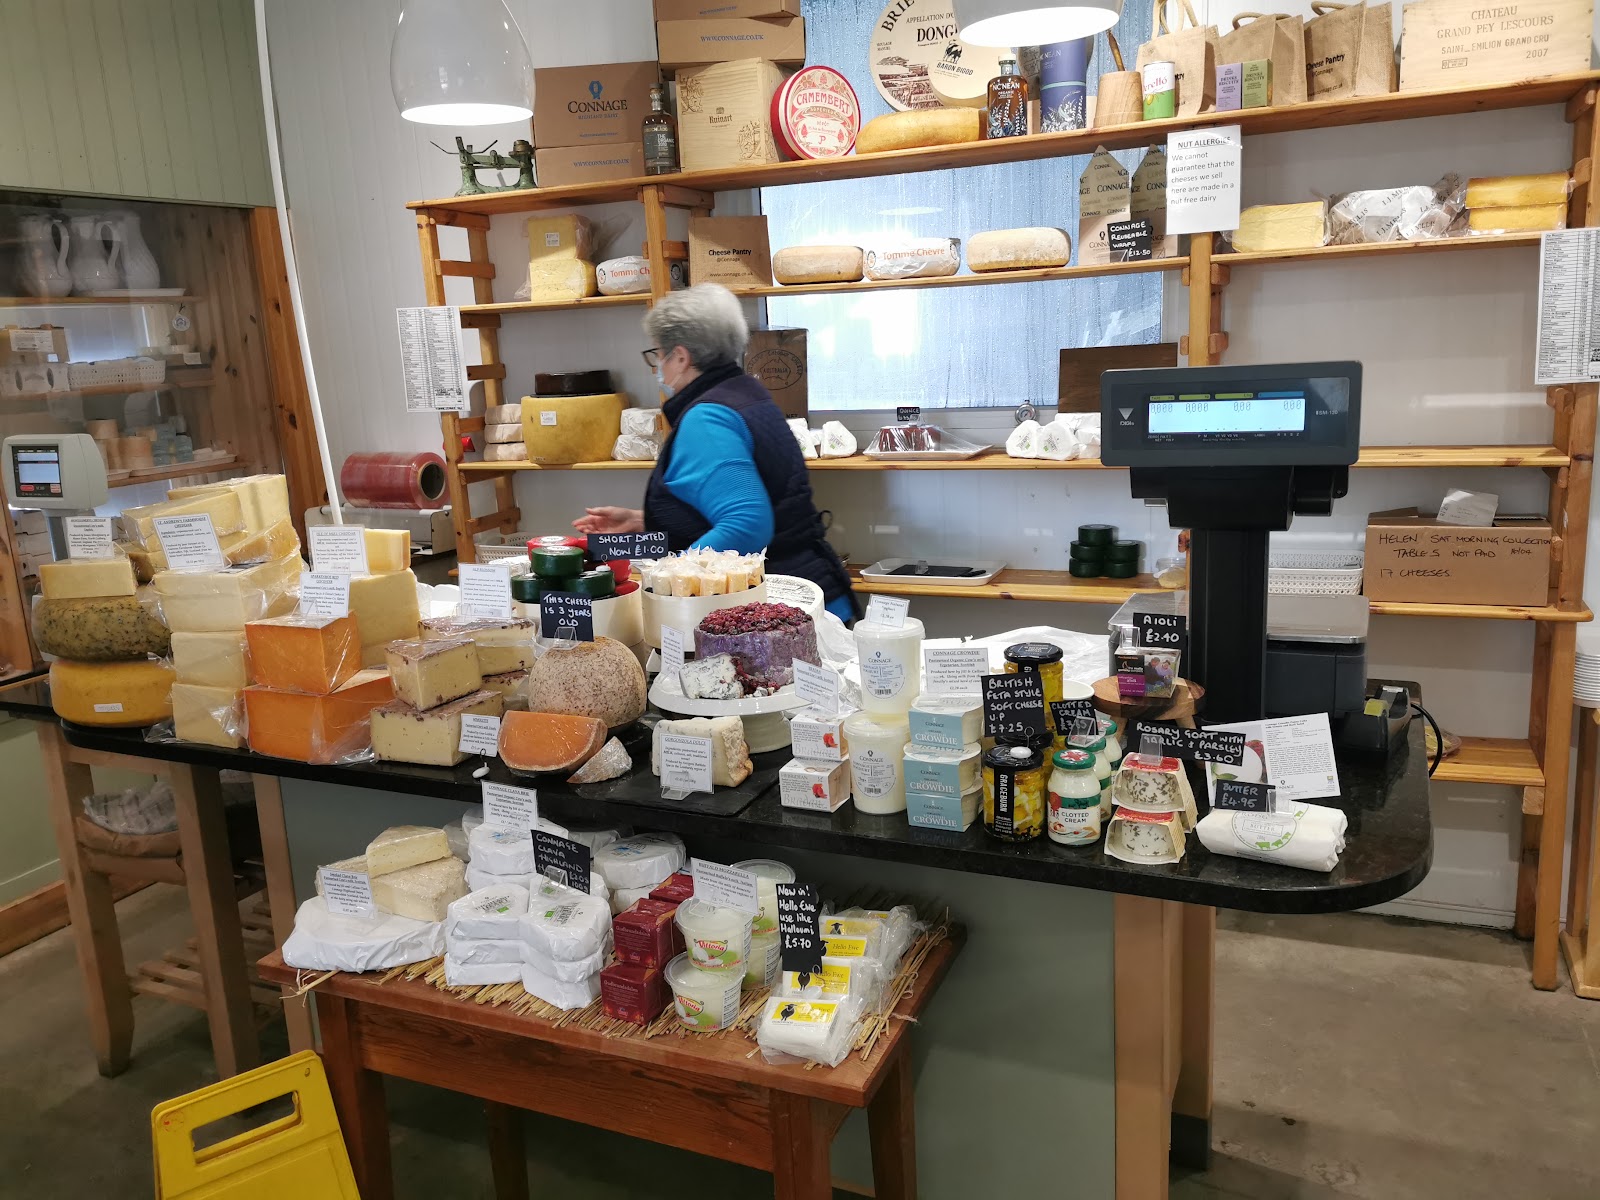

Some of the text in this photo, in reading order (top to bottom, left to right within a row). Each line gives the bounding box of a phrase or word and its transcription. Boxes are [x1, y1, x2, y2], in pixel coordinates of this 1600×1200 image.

[1471, 6, 1517, 20] CHATEAU
[916, 24, 957, 42] DONG
[1437, 15, 1554, 39] GRAND PEY LESCOURS
[1505, 37, 1532, 47] GRAND
[1534, 34, 1550, 44] CRU
[1325, 54, 1346, 65] Pantry
[1526, 49, 1549, 59] 2007
[936, 62, 956, 73] BARON
[567, 99, 628, 114] CONNAGE
[796, 91, 851, 116] CAMEMBERT
[709, 114, 734, 125] Ruinart
[1177, 140, 1193, 149] NUT
[1185, 152, 1208, 161] cannot
[1171, 164, 1206, 174] guarantee
[1171, 176, 1198, 184] cheeses
[1097, 182, 1129, 193] CONNAGE
[1201, 183, 1221, 191] made
[1110, 221, 1146, 232] CONNAGE
[1112, 241, 1136, 249] WRAPS
[709, 248, 752, 257] Cheese Pantry
[883, 250, 915, 261] Tomme
[610, 268, 638, 278] Tomme
[598, 531, 666, 544] SHORT DATED
[1379, 533, 1418, 545] HELEN
[1430, 534, 1452, 544] SAT
[1456, 535, 1500, 546] MORNING
[609, 547, 632, 557] NOW
[1452, 549, 1470, 558] NOT
[1474, 548, 1497, 558] PAID
[1381, 569, 1452, 579] 17 CHEESES
[543, 593, 592, 607] THIS CHEESE
[544, 606, 592, 618] IS 3 YEARS
[558, 617, 579, 627] OLD
[1145, 628, 1180, 643] £2.40
[988, 677, 1033, 689] BRITISH
[986, 687, 1042, 701] FETA STYLE
[990, 699, 1043, 711] SOFT CHEESE
[1051, 700, 1092, 710] CLOTTED
[1058, 709, 1092, 717] CREAM
[915, 732, 958, 746] CROWDIE
[1136, 722, 1244, 744] ROSARY GOAT WITH
[1199, 740, 1242, 757] PARSLEY
[1194, 750, 1234, 764] £3.60
[909, 781, 955, 794] CROWDIE
[1000, 774, 1009, 813] GRACEBURN
[1222, 782, 1259, 796] BUTTER
[1221, 793, 1258, 808] £4.95
[912, 815, 958, 828] CROWDIE
[536, 833, 579, 854] CONNAGE
[537, 844, 566, 859] CLAVA
[538, 853, 584, 873] HIGHLAND
[777, 885, 811, 897] New in!
[778, 899, 816, 912] Hello Ewe
[780, 913, 814, 924] use like
[780, 923, 815, 935] Halloumi
[698, 940, 725, 951] Vittoria
[784, 934, 812, 949] £5.70
[677, 995, 701, 1012] Vittoria
